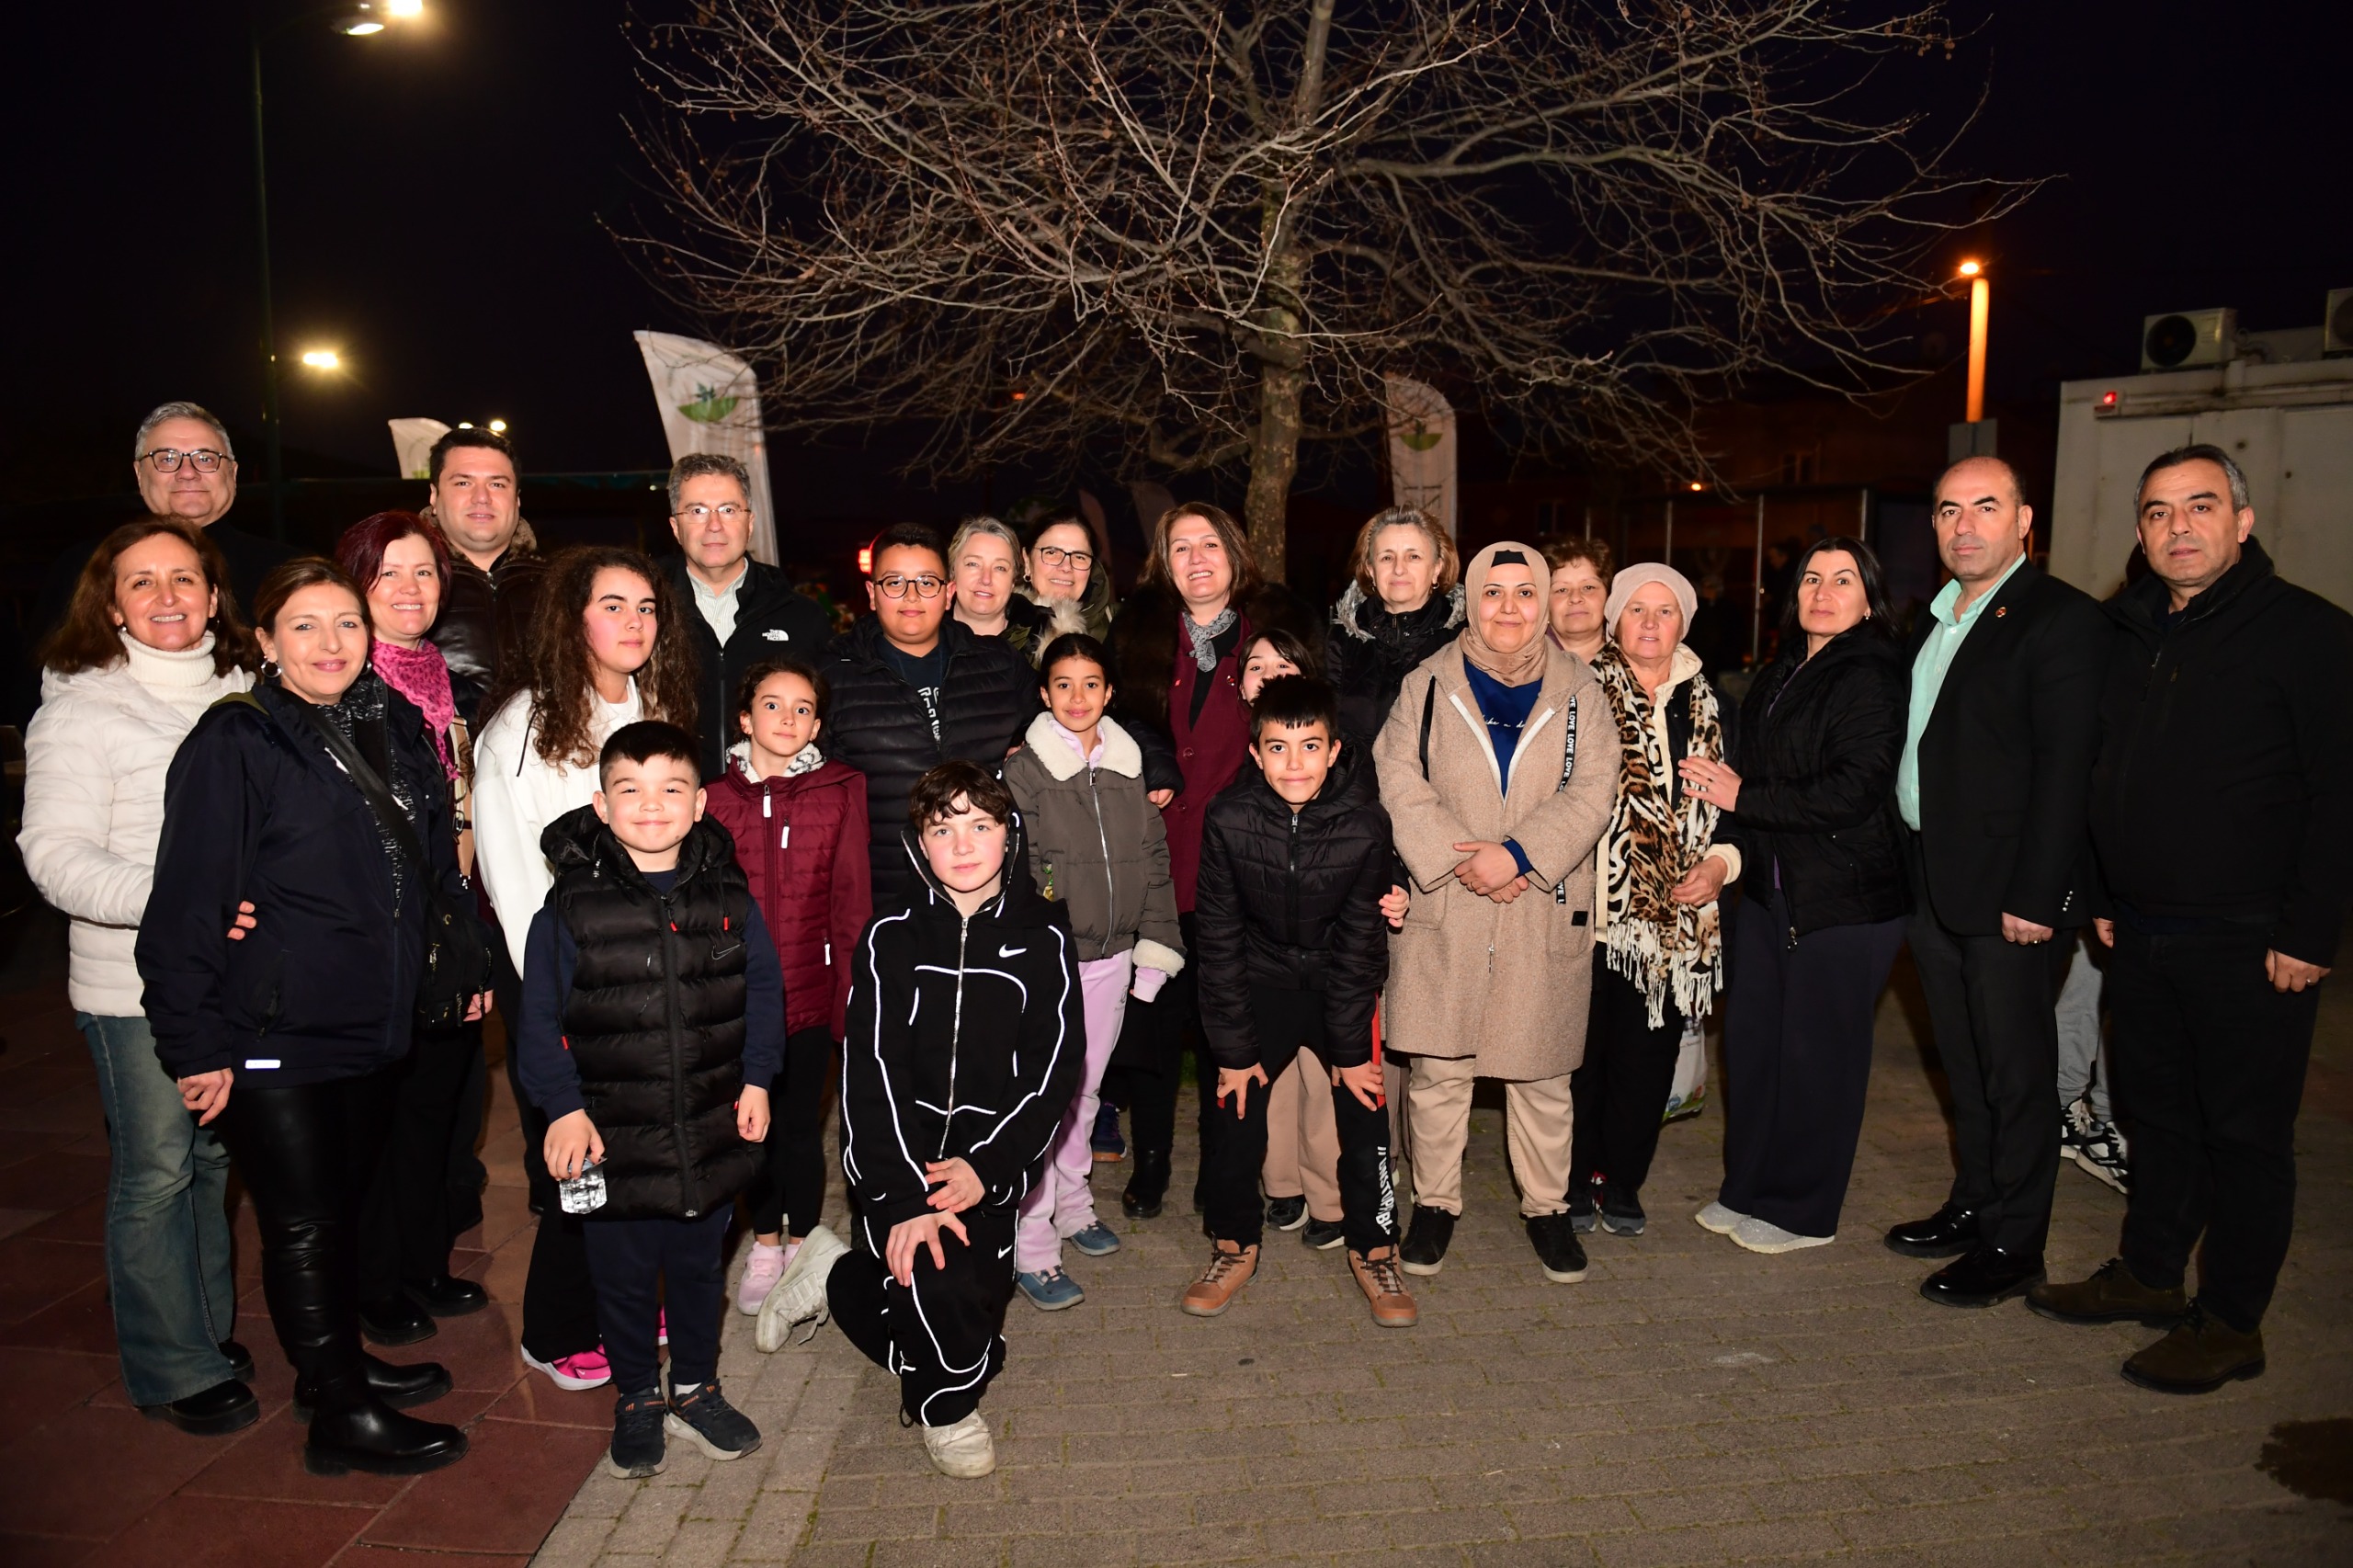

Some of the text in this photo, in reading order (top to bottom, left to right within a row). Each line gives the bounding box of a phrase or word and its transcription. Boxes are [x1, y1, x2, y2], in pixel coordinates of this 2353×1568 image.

[1566, 733, 1574, 754] LOVE
[1563, 756, 1573, 778] LOVE
[1376, 1156, 1394, 1235] UNSTOPABL
